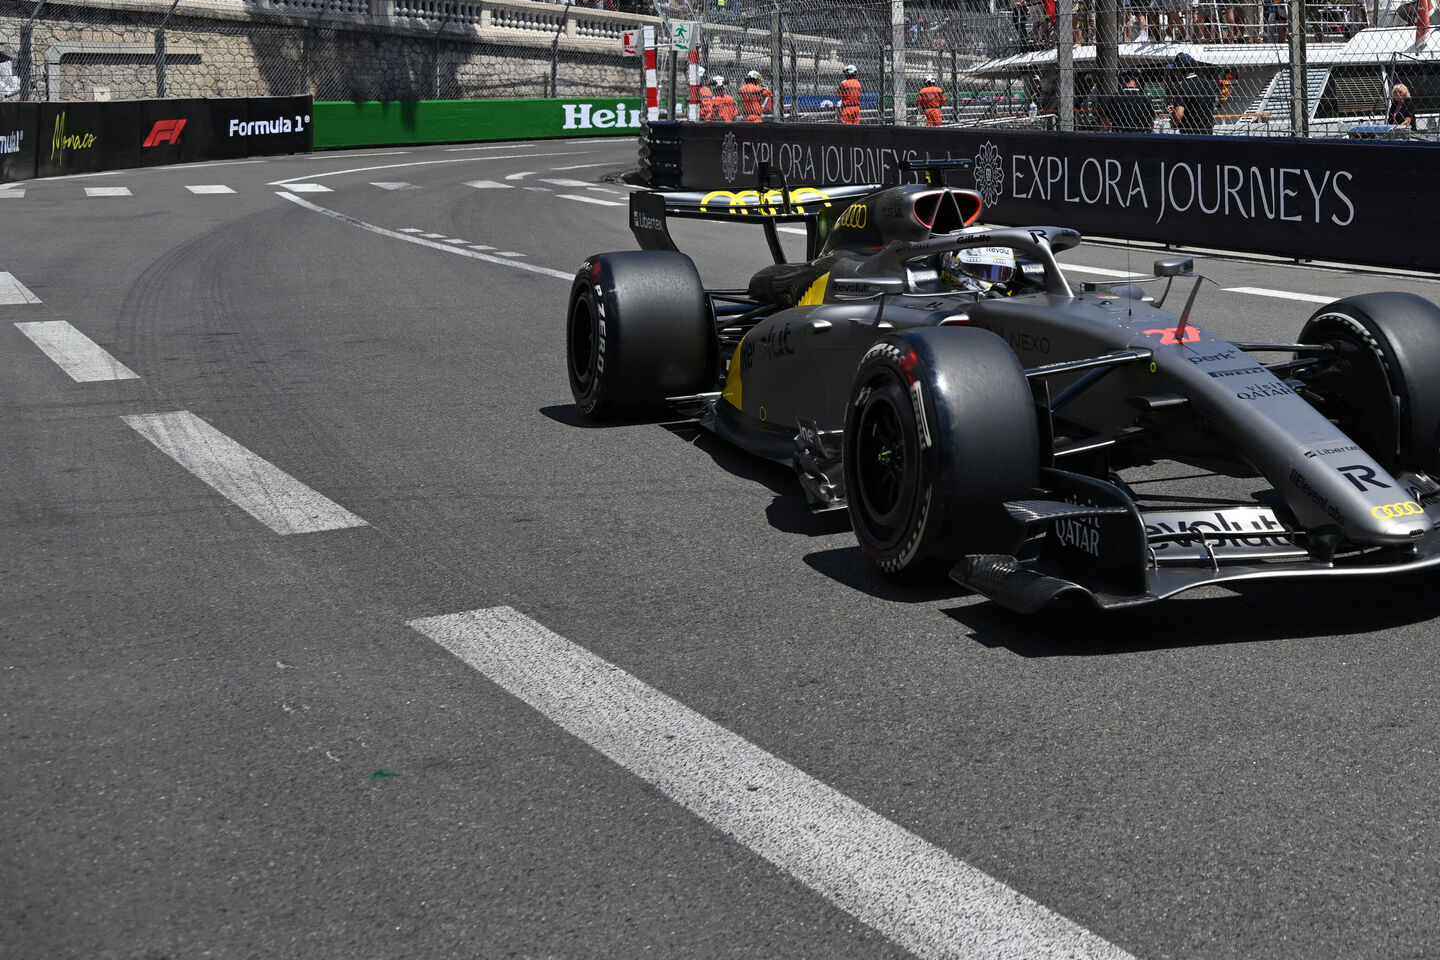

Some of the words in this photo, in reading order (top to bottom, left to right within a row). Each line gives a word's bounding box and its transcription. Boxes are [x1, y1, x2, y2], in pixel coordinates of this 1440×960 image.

[229, 117, 292, 137] Formula
[51, 111, 97, 166] Monaco
[1012, 155, 1149, 208] EXPLORA
[1156, 161, 1355, 227] JOURNEYS
[639, 211, 664, 231] Libertex
[957, 234, 991, 244] Gillette
[832, 283, 869, 293] Revolut
[597, 302, 606, 374] ZERO
[1010, 332, 1050, 354] NEXO
[1237, 388, 1295, 400] QATAR
[1246, 382, 1287, 390] visit
[1316, 445, 1361, 456] Liberte
[1336, 465, 1393, 492] R
[1055, 518, 1100, 557] QATAR
[1146, 512, 1292, 550] evolut
